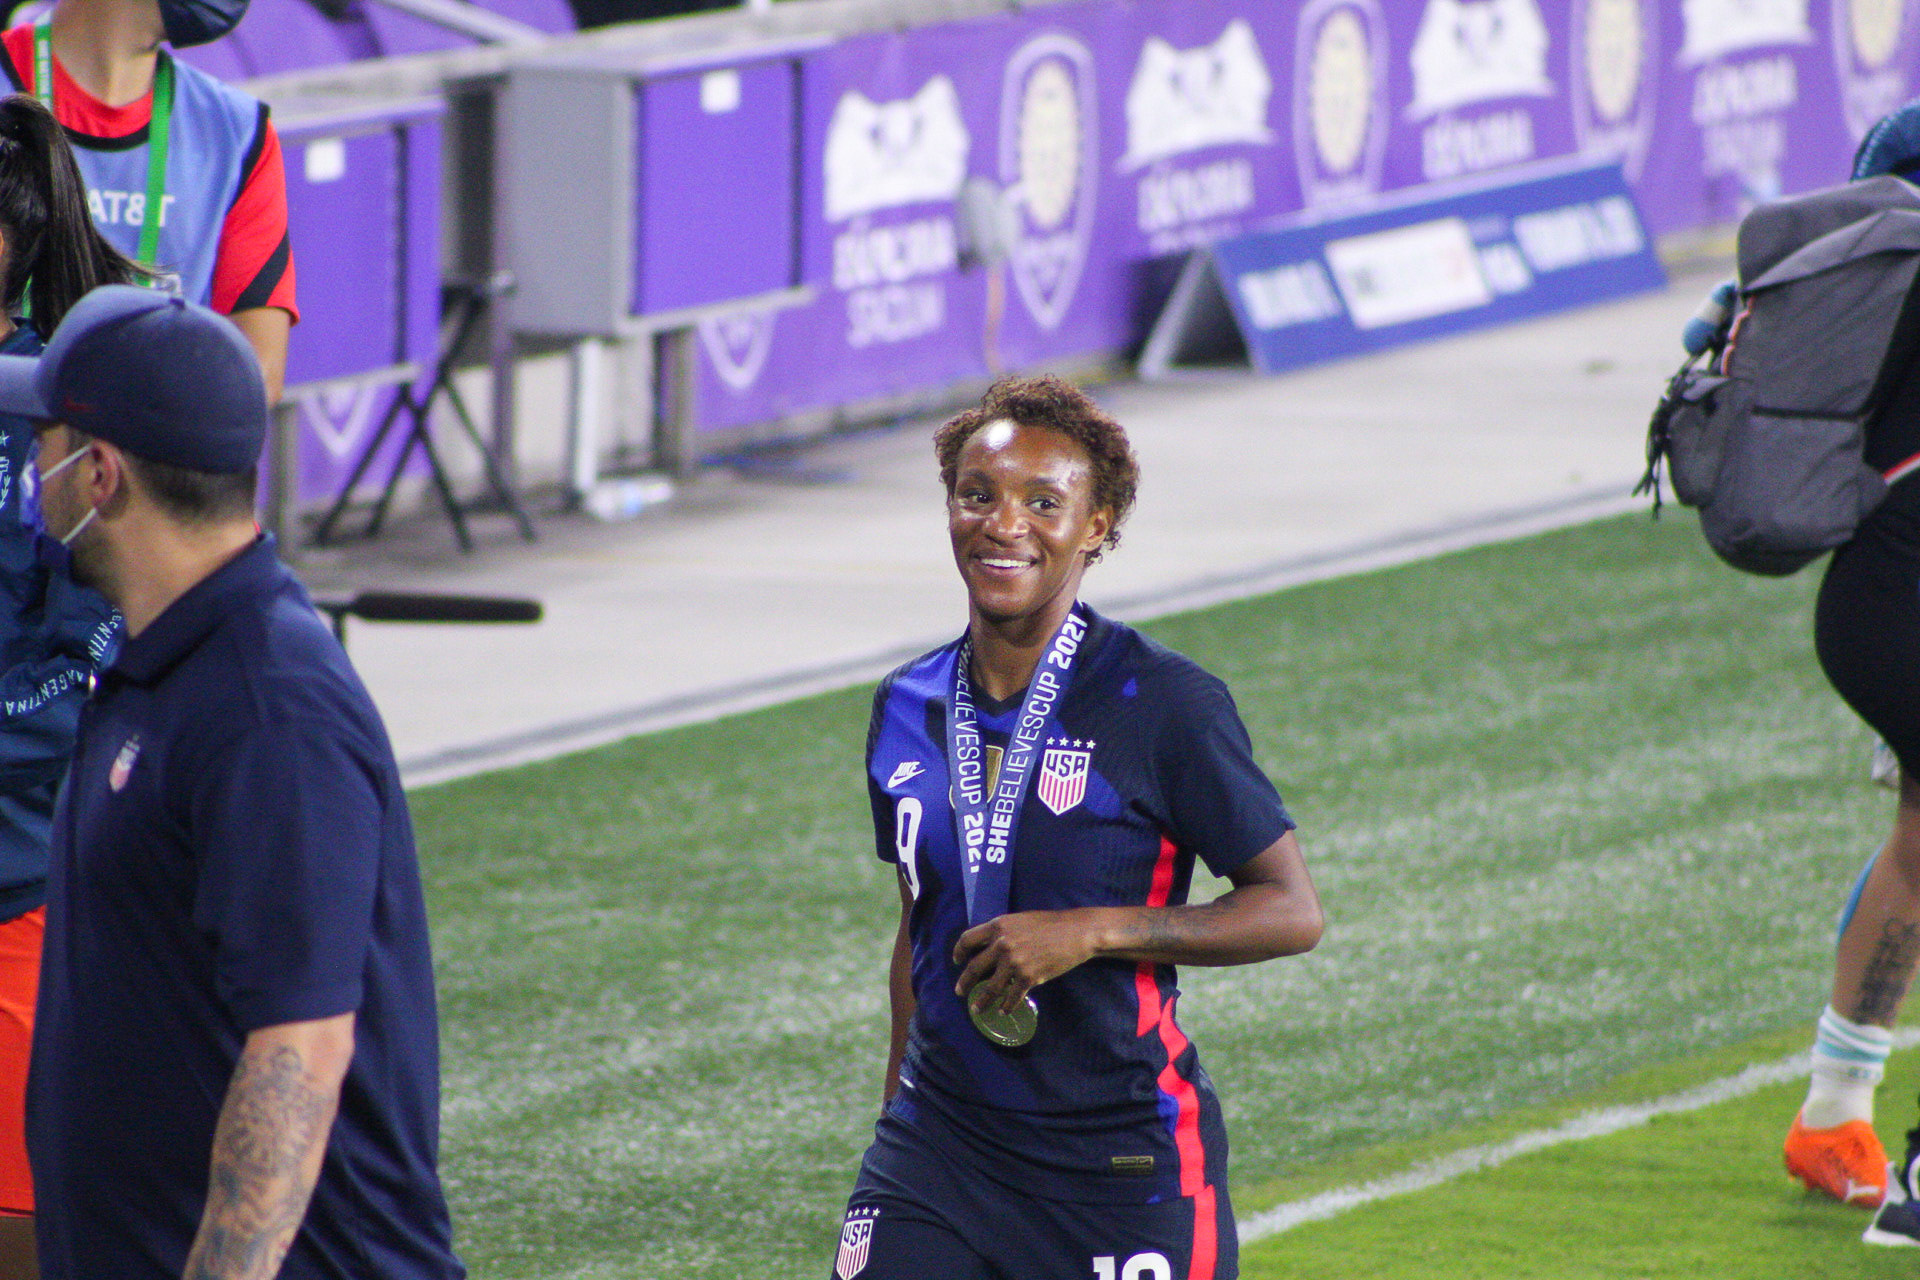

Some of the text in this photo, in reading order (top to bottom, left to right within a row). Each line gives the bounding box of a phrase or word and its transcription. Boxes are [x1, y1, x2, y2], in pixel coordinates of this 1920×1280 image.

[87, 188, 175, 228] AT&T
[5, 669, 84, 716] ARGENTINA
[985, 613, 1089, 865] SHEBELIEVESCUP 2021
[1045, 753, 1087, 778] USA
[843, 1223, 871, 1247] USA
